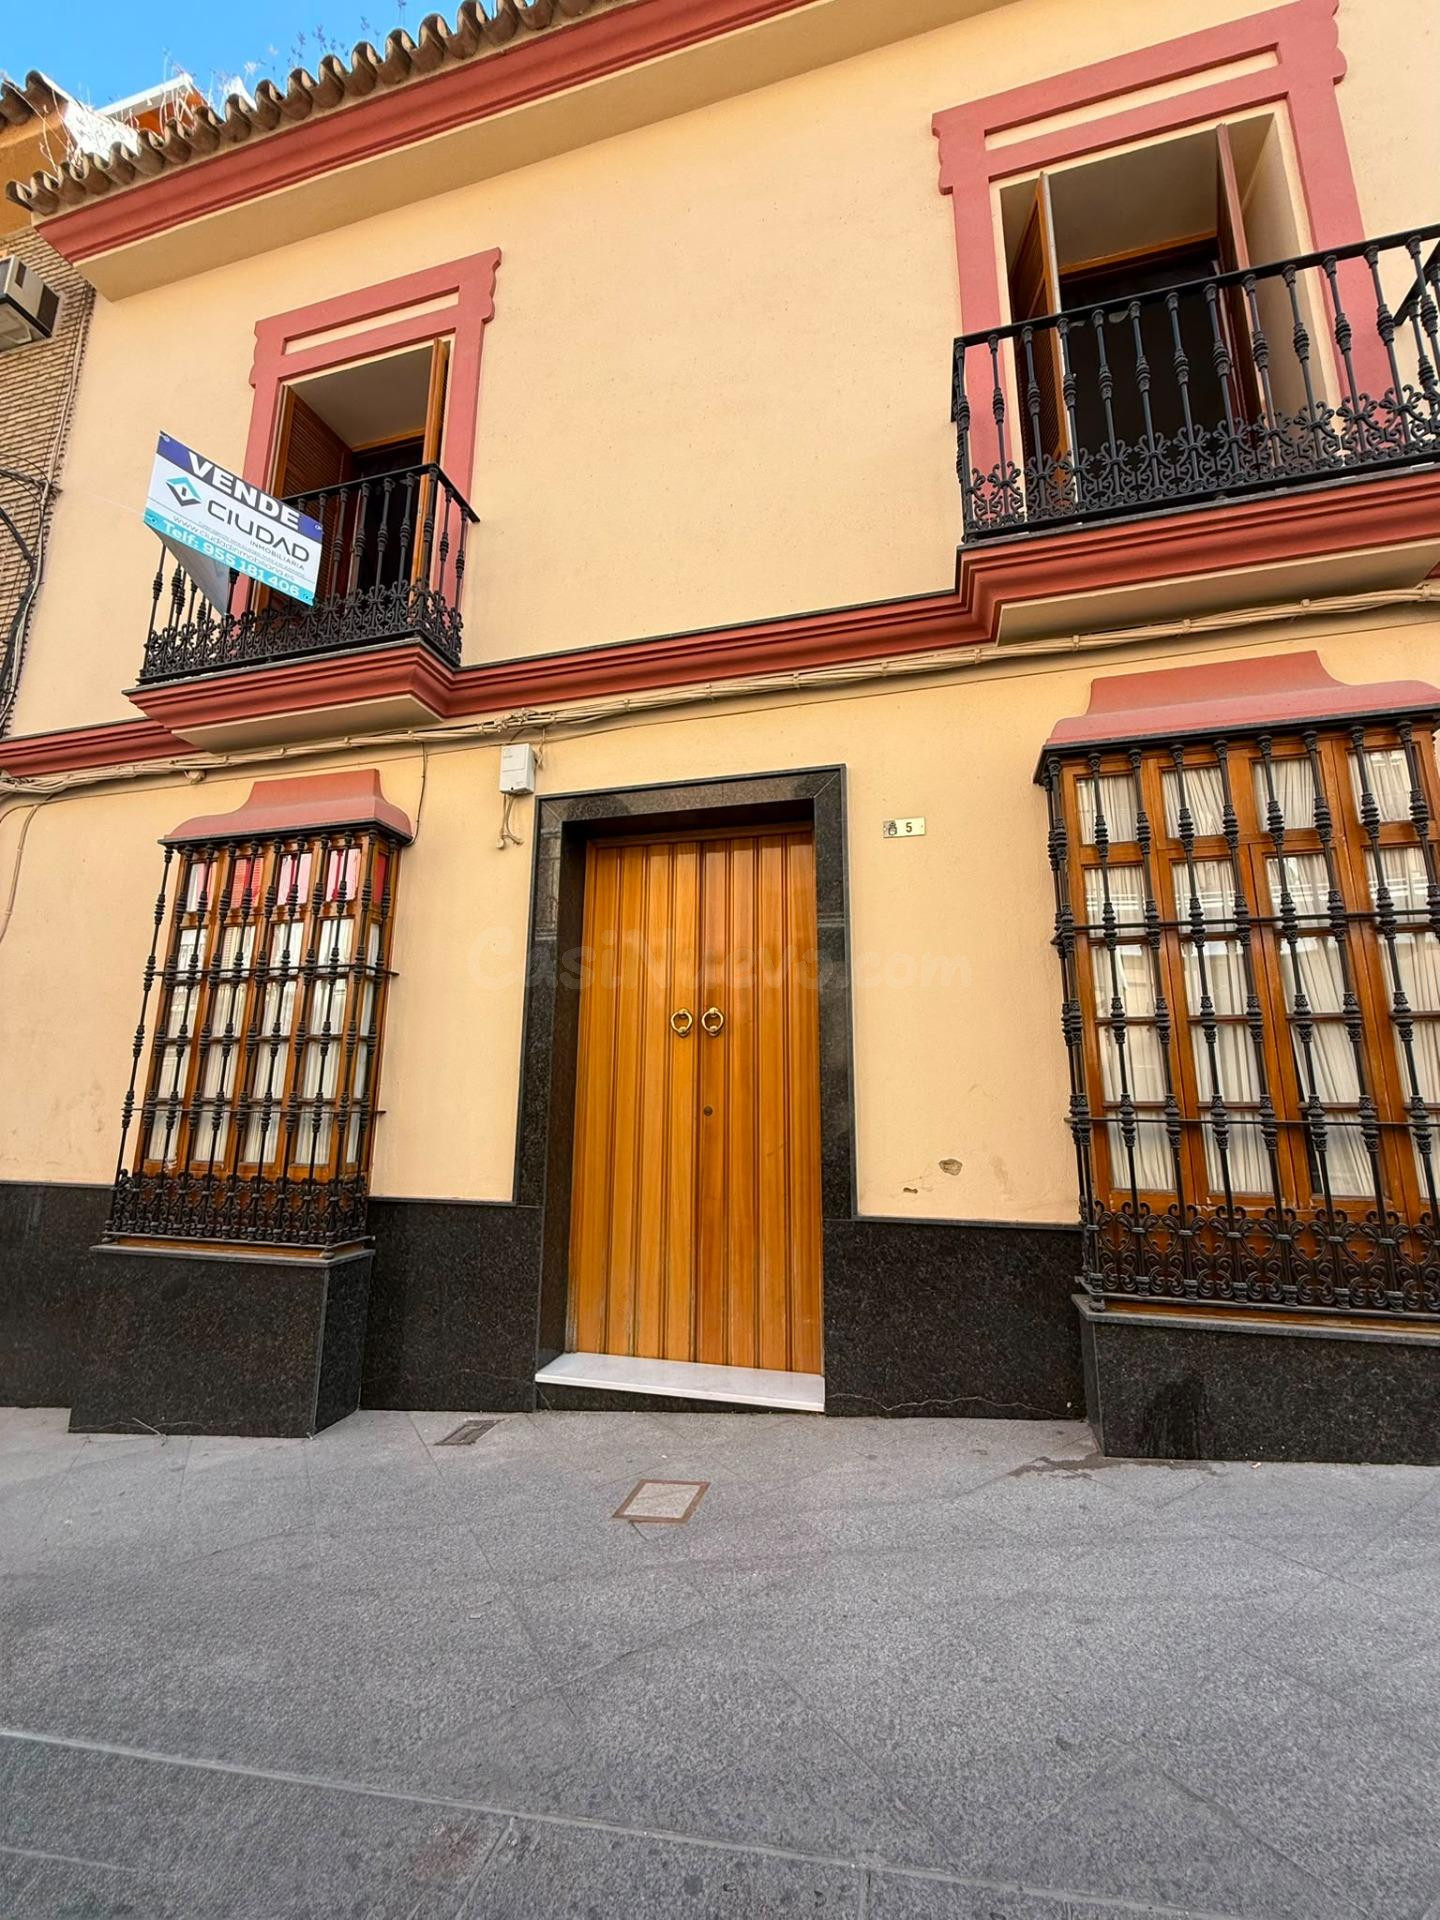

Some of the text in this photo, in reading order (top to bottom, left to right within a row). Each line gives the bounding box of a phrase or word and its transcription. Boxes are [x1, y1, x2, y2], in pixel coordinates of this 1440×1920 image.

[189, 450, 301, 530] VENDE
[162, 519, 300, 595] Telf: 955 181 406
[207, 499, 310, 562] CIUDAD
[250, 541, 305, 571] INMOBILIARIA
[905, 821, 913, 833] 5
